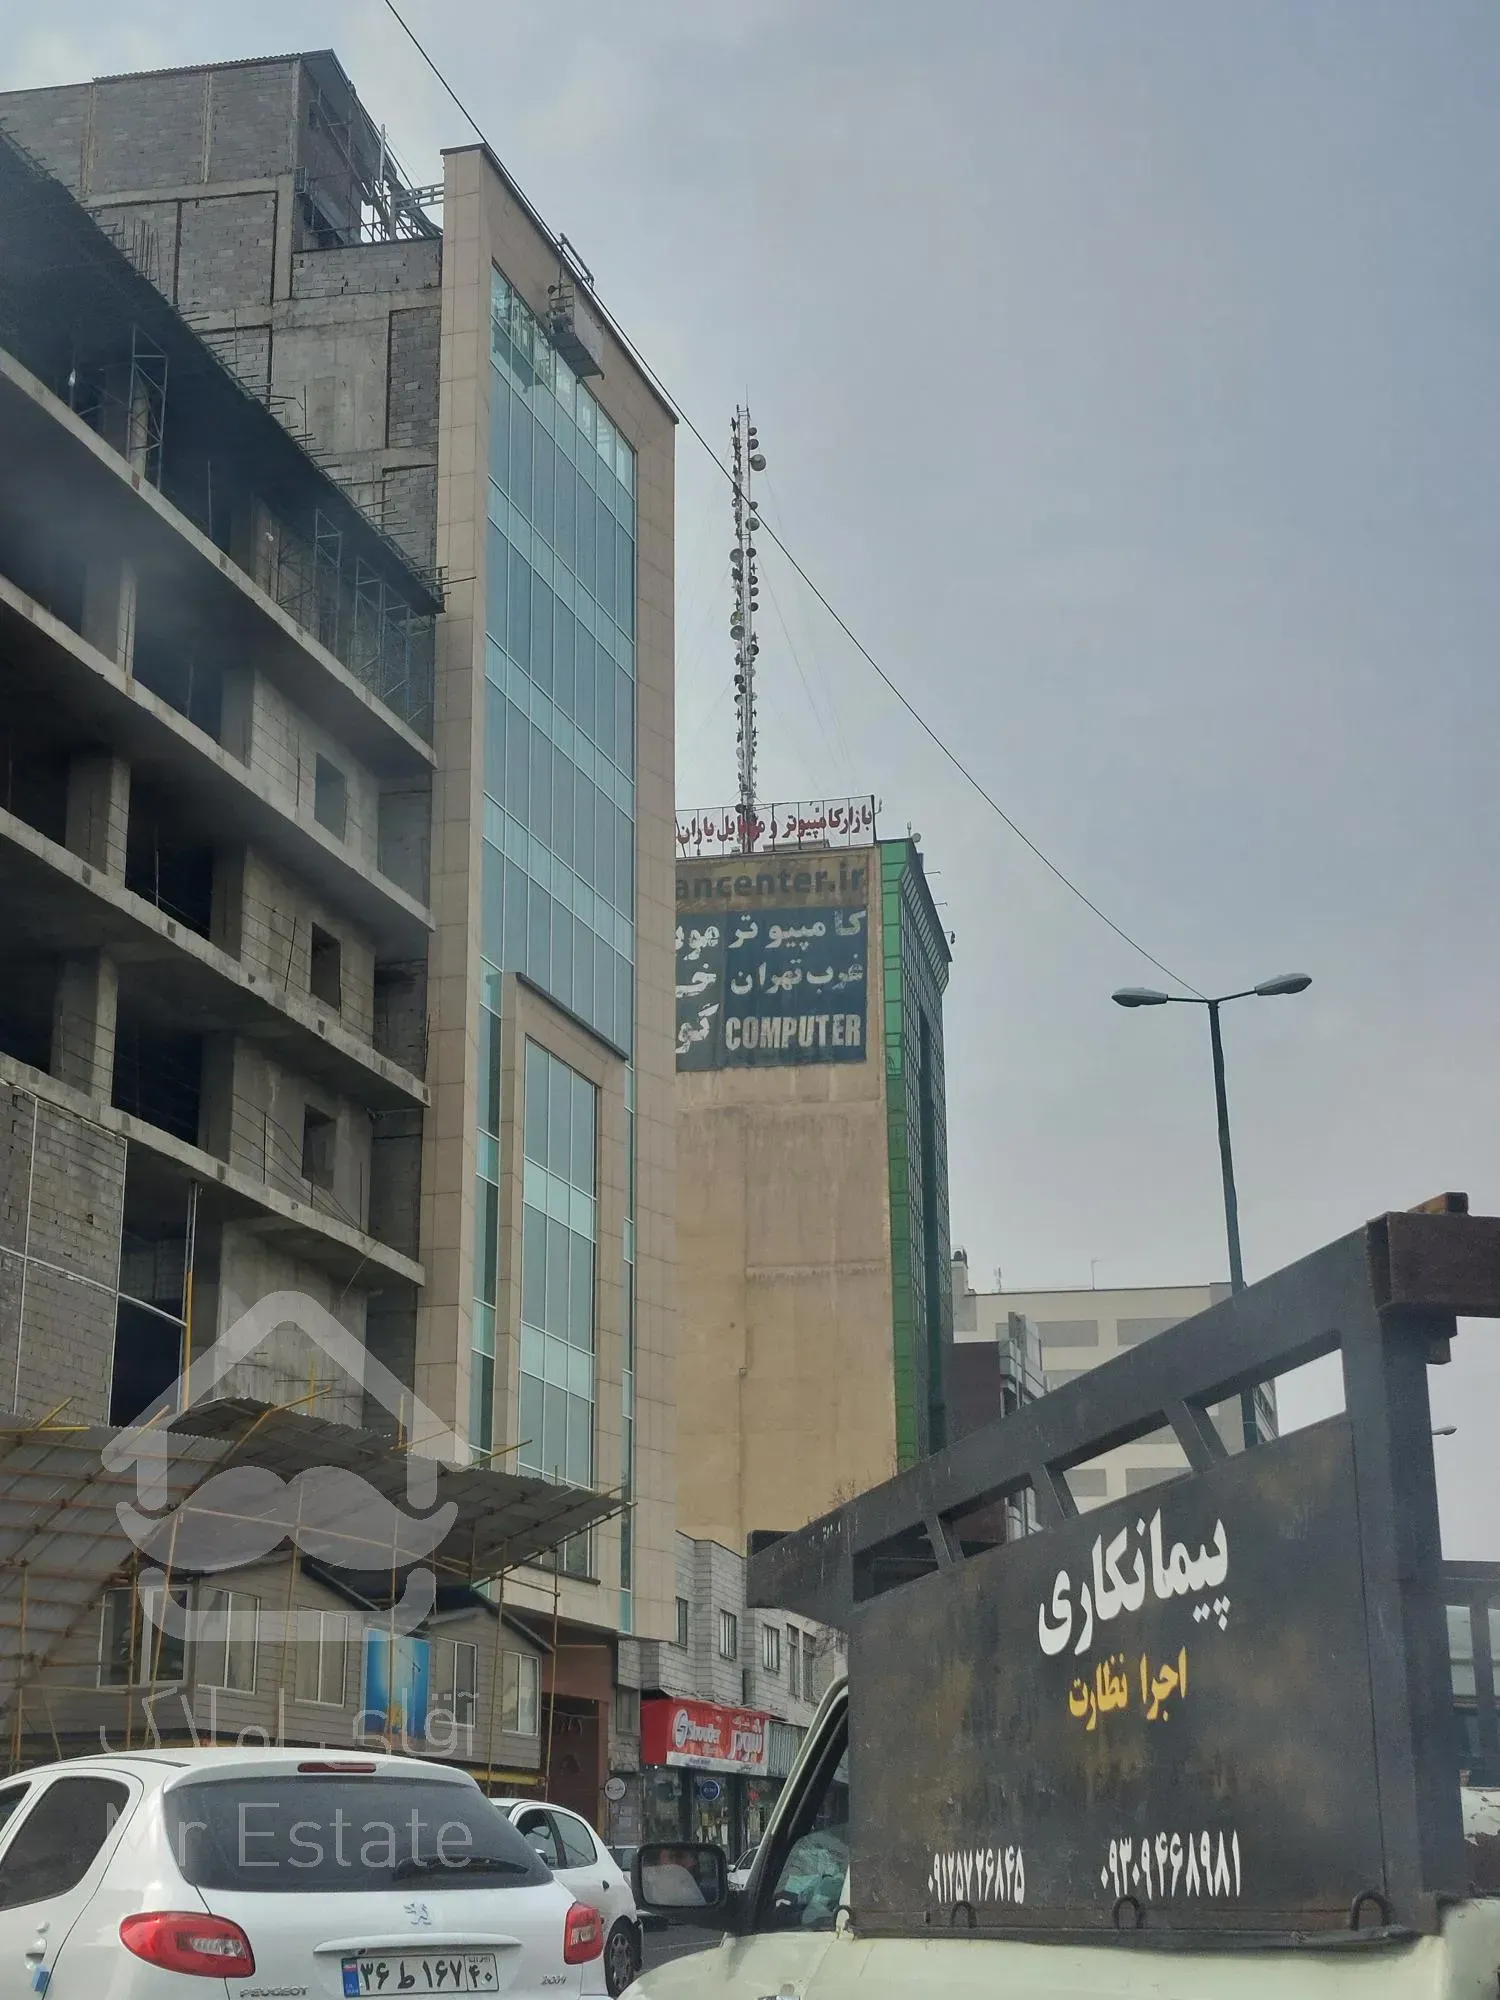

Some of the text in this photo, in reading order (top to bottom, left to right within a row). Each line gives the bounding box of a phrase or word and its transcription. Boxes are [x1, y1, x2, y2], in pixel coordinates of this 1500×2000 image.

[768, 820, 778, 840] و
[839, 804, 873, 835] بازار
[730, 958, 803, 996] تهران
[725, 1013, 862, 1051] COMPUTER
[1038, 1508, 1230, 1656] پیمانکاری
[1068, 1646, 1188, 1731] اجرا نظارت
[239, 1986, 309, 1998] PEUGEOT
